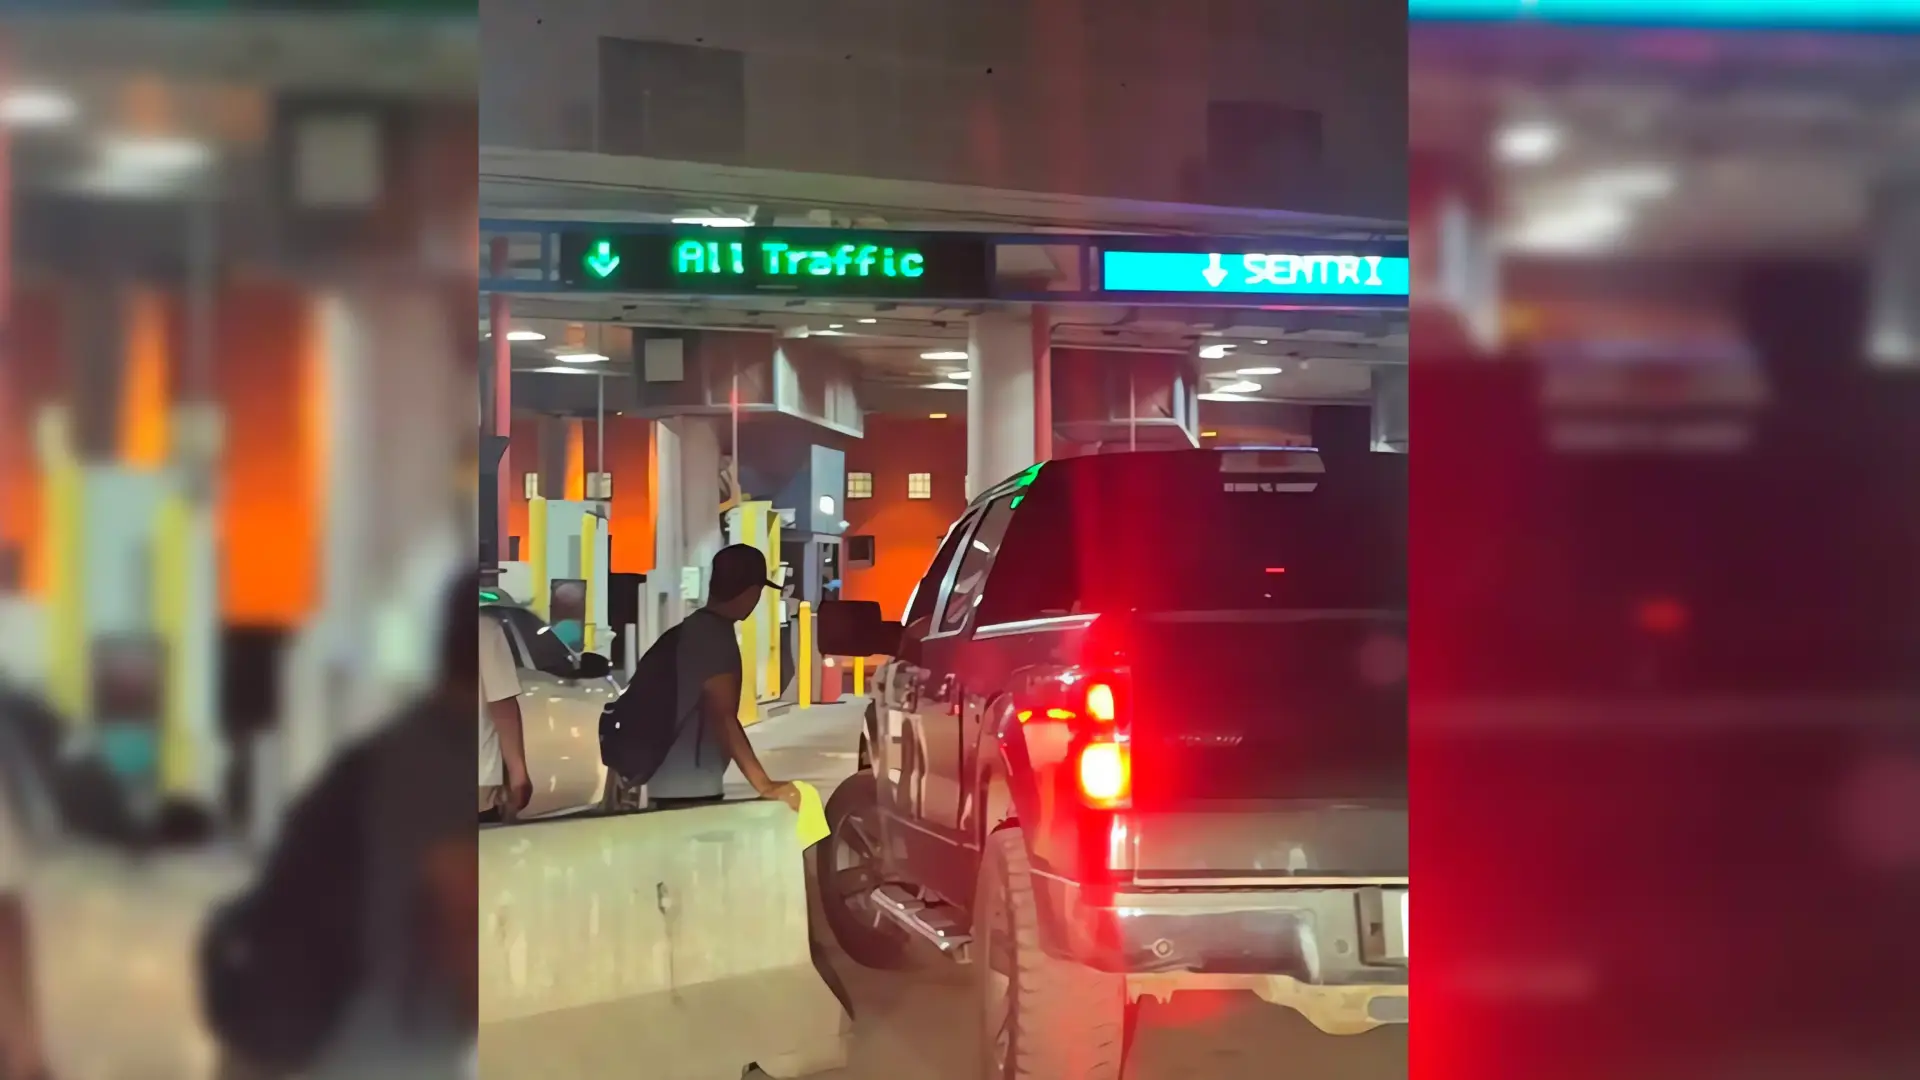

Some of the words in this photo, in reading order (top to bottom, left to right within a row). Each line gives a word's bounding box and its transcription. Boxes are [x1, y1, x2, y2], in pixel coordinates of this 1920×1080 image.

[675, 240, 744, 274] All
[761, 241, 924, 277] Traffic
[1243, 253, 1382, 286] SENTRI
